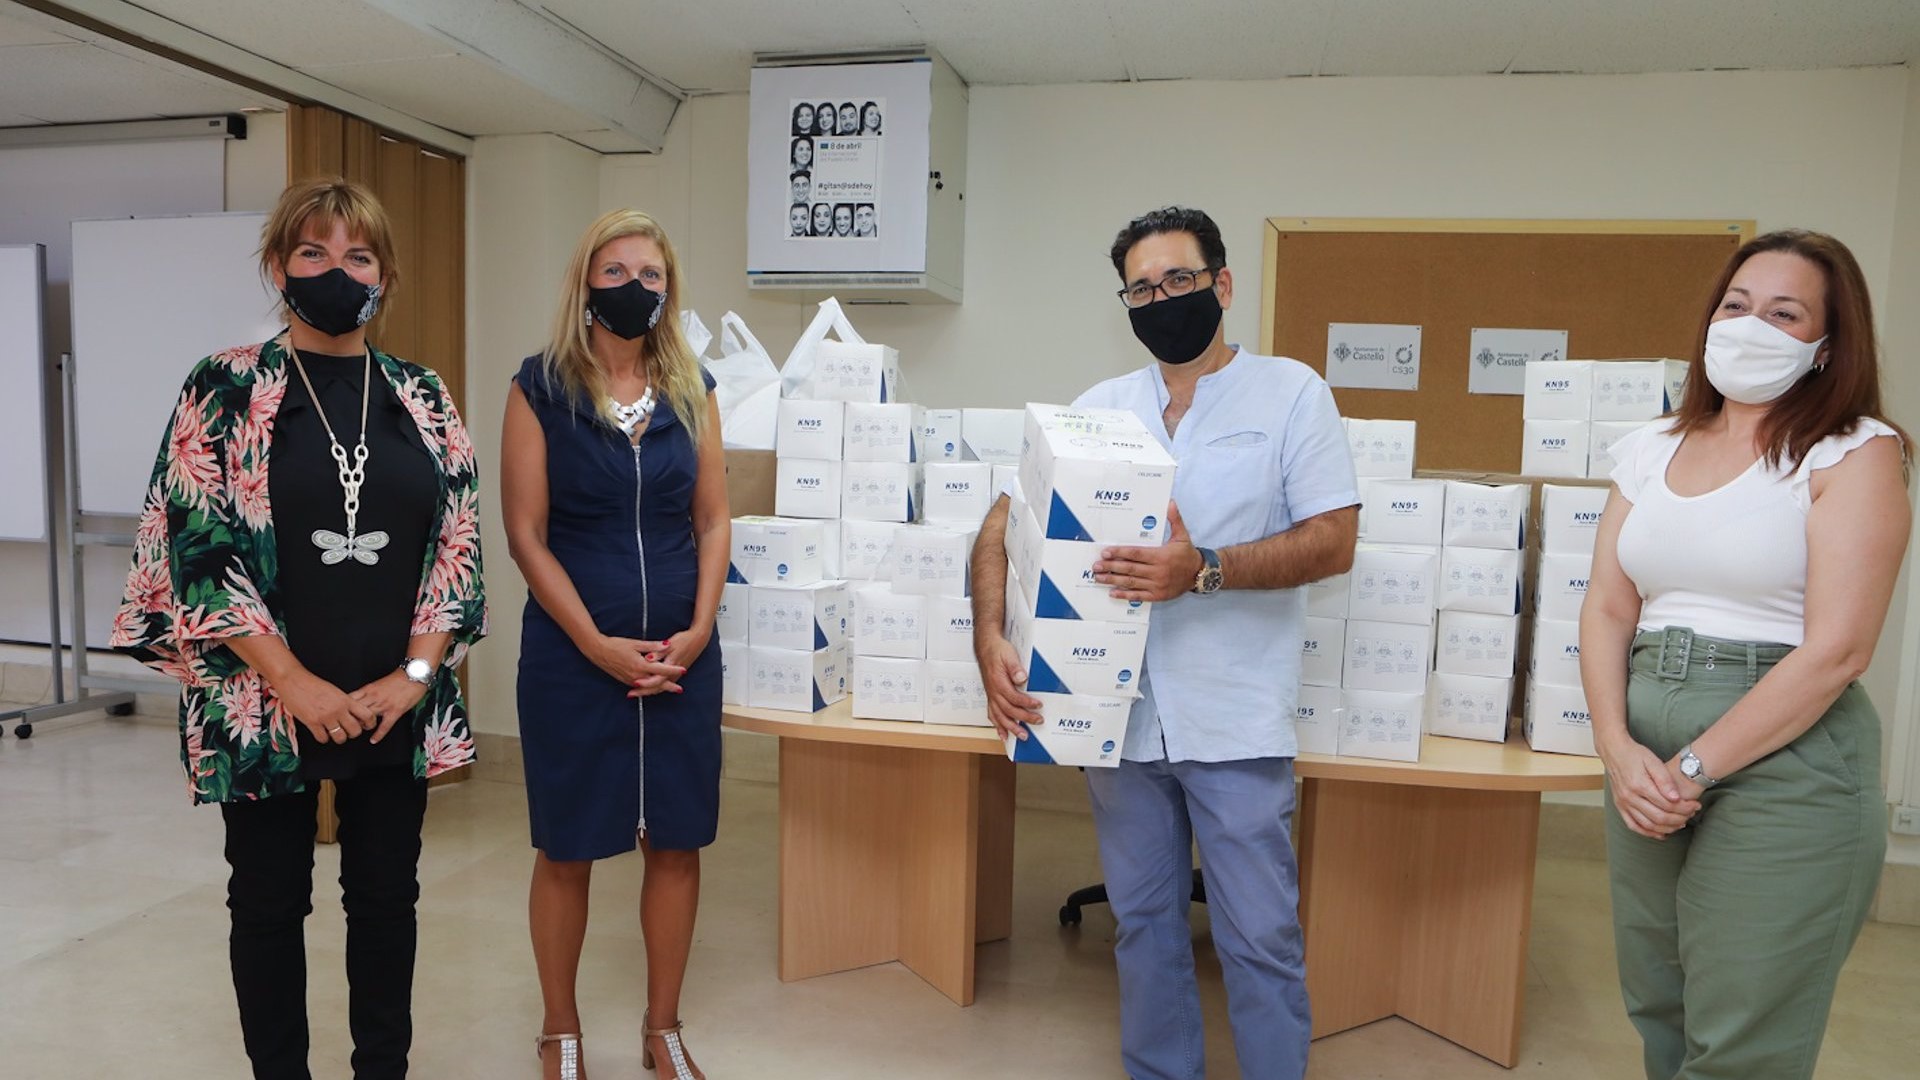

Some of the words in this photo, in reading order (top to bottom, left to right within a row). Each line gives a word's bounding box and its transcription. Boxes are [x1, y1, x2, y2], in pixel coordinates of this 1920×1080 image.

[1544, 380, 1570, 388] KN95
[797, 419, 821, 427] KN95
[1541, 438, 1567, 446] KN95
[796, 478, 820, 486] KN95
[945, 482, 970, 490] KN95
[1095, 490, 1130, 501] KN95
[1391, 501, 1418, 510] KN95
[743, 544, 767, 553] KN95
[1569, 579, 1590, 588] KN9
[1303, 640, 1318, 650] 95
[1565, 645, 1580, 654] KN
[1072, 647, 1107, 657] KN95
[1297, 707, 1315, 717] 95
[1562, 710, 1592, 721] KN95
[1058, 718, 1094, 729] KN95
